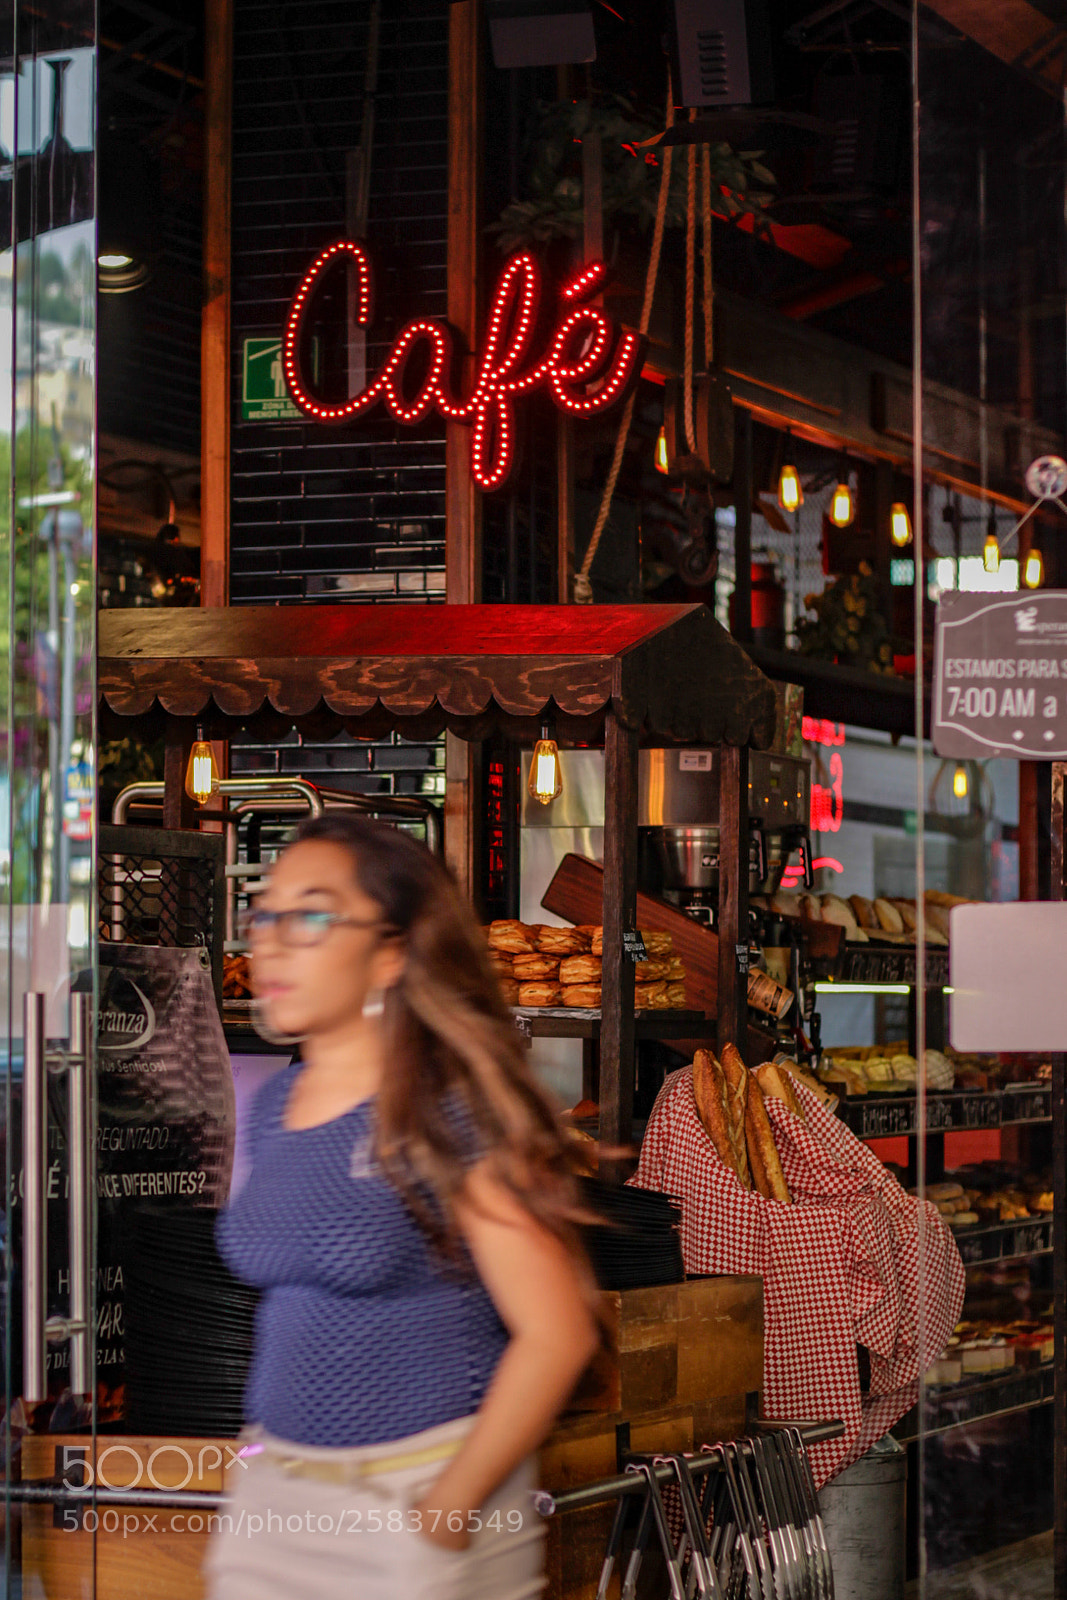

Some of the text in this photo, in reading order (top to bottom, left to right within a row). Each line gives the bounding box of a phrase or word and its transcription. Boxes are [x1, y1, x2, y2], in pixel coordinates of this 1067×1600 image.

[284, 238, 640, 488] Café
[944, 658, 1016, 679] ESTAMOS
[1018, 659, 1059, 679] PARA
[947, 686, 1057, 718] 7:00 AM a
[93, 1126, 170, 1151] REGUNTADO
[122, 1171, 206, 1197] DIFERENTES?
